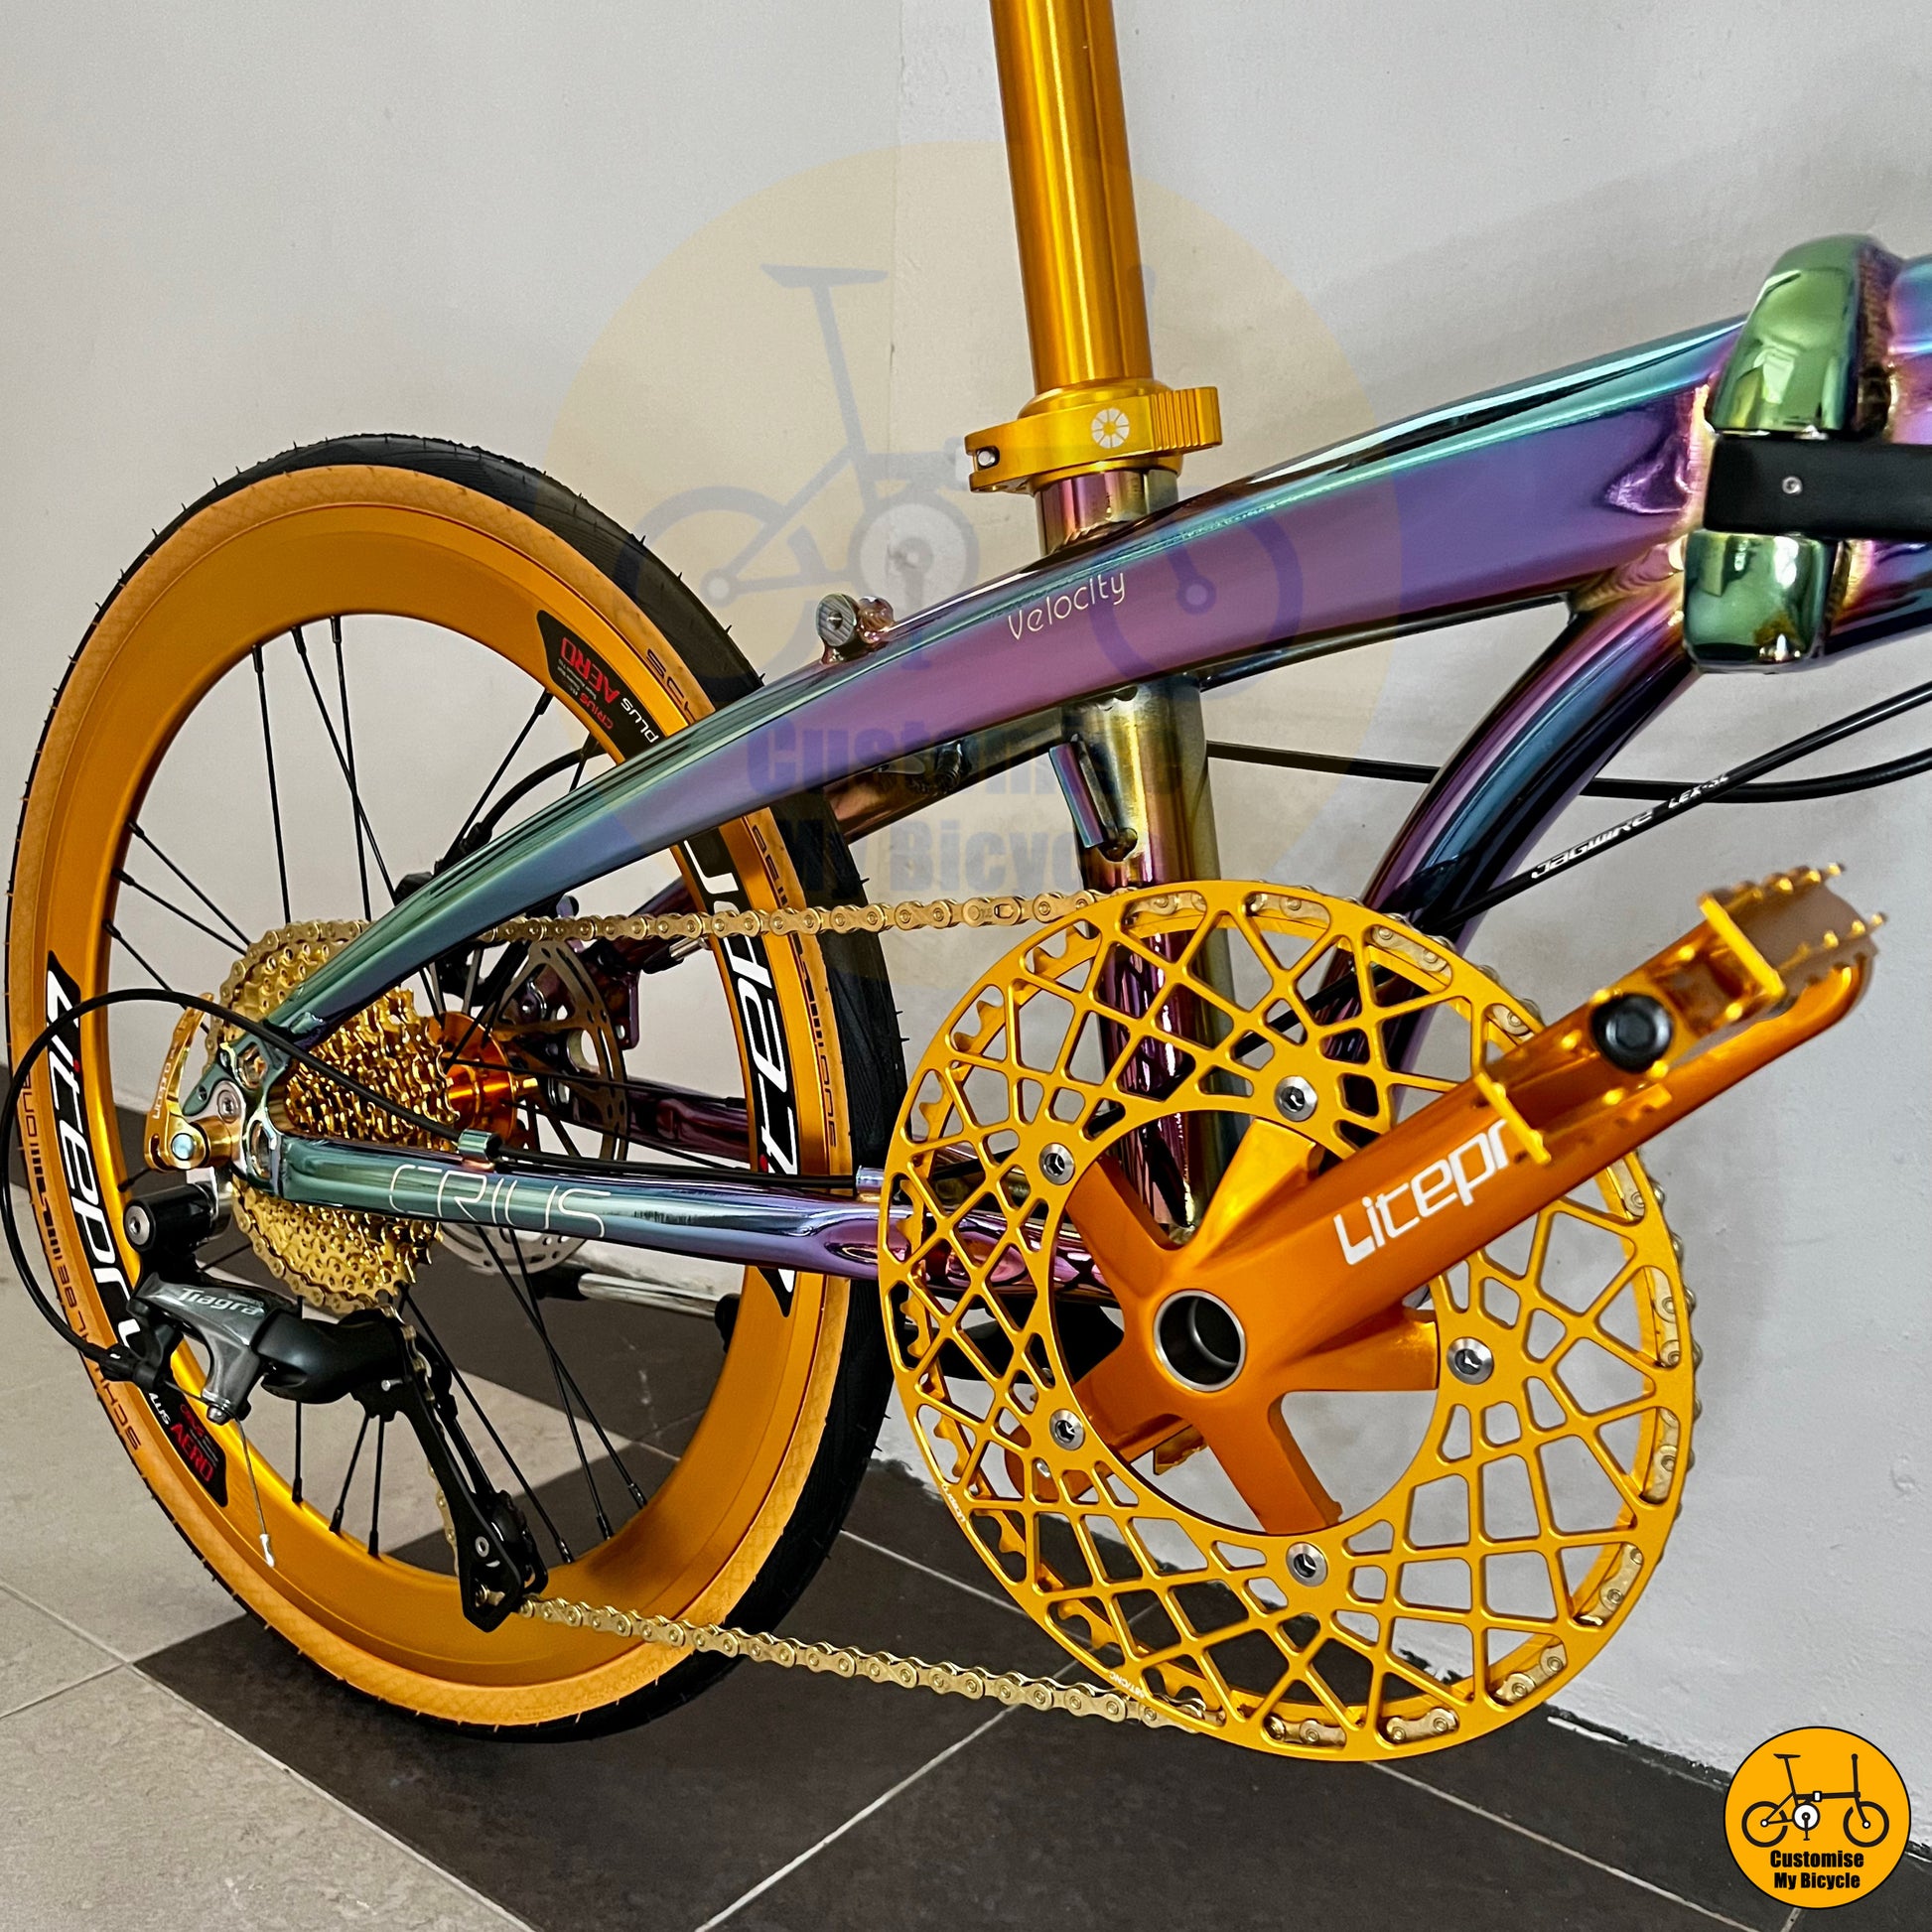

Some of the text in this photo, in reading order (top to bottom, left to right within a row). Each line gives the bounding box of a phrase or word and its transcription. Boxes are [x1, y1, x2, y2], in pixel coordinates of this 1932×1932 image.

[1008, 572, 1126, 640] Velocity
[560, 636, 621, 704] AERO
[579, 692, 615, 730] CRIUS
[47, 970, 142, 1352] Litepr
[1333, 1118, 1510, 1266] Litepr
[389, 1164, 612, 1238] CRIUS
[179, 1287, 266, 1316] Tiagra
[57, 1263, 142, 1451] SCHLBE
